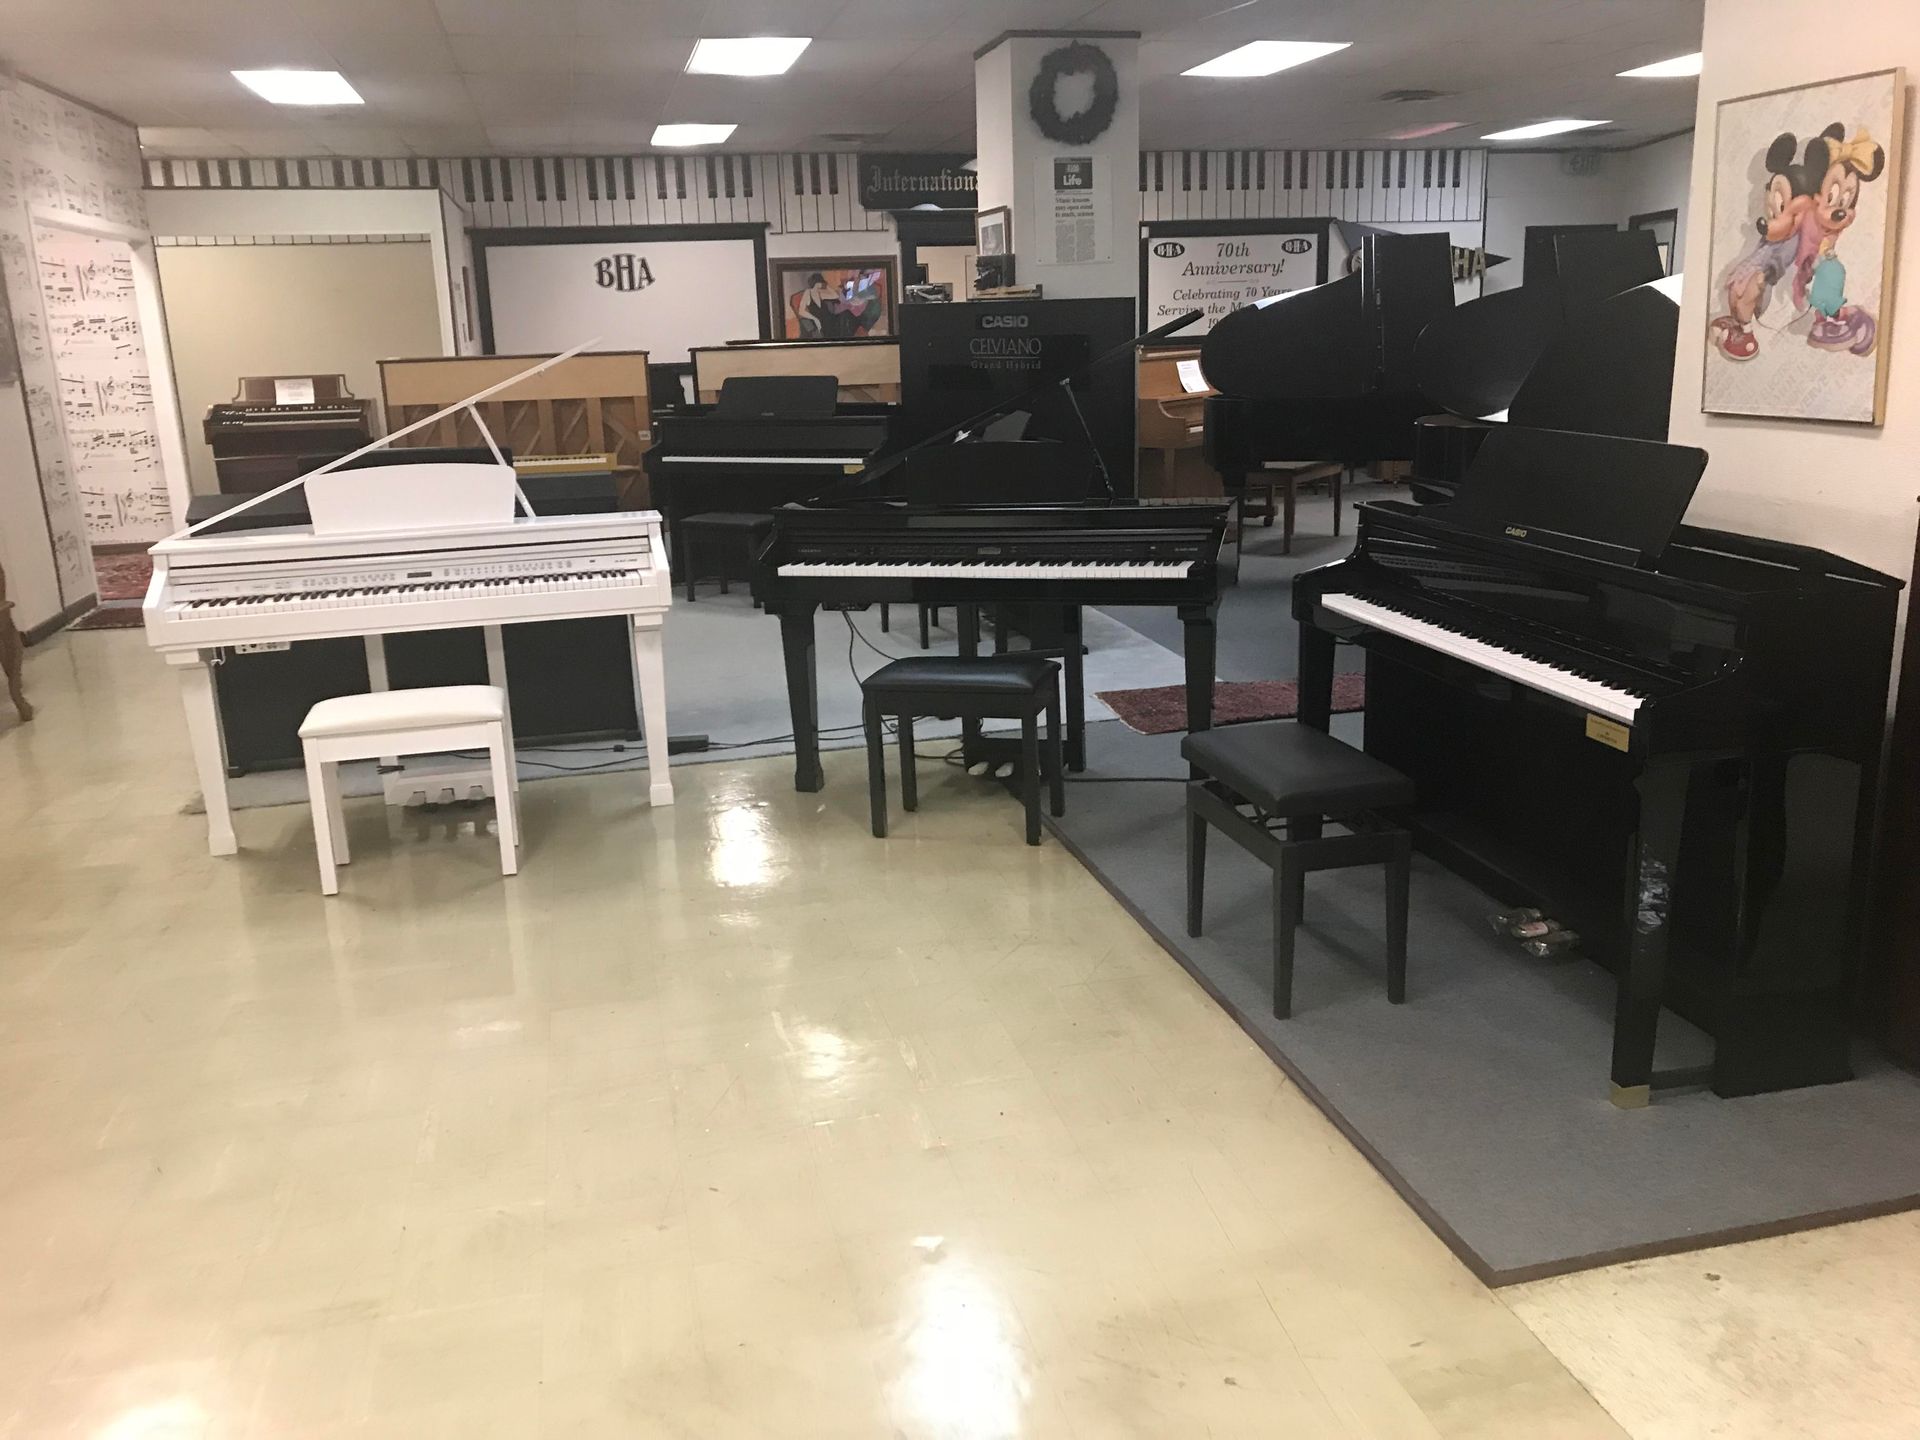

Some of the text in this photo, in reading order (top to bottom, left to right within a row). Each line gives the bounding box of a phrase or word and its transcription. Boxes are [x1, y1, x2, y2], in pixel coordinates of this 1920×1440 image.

[1063, 174, 1082, 186] Life
[1217, 242, 1249, 258] 70th
[594, 253, 656, 292] BHA
[1181, 258, 1285, 277] Anniversary!
[1173, 289, 1240, 300] Celebrating
[1246, 286, 1257, 297] 70
[1208, 302, 1226, 314] the
[982, 315, 1029, 328] CASIO
[969, 338, 1042, 355] CELVIANO
[970, 360, 1041, 371] Grand Hybrid
[1505, 526, 1528, 538] CASIO
